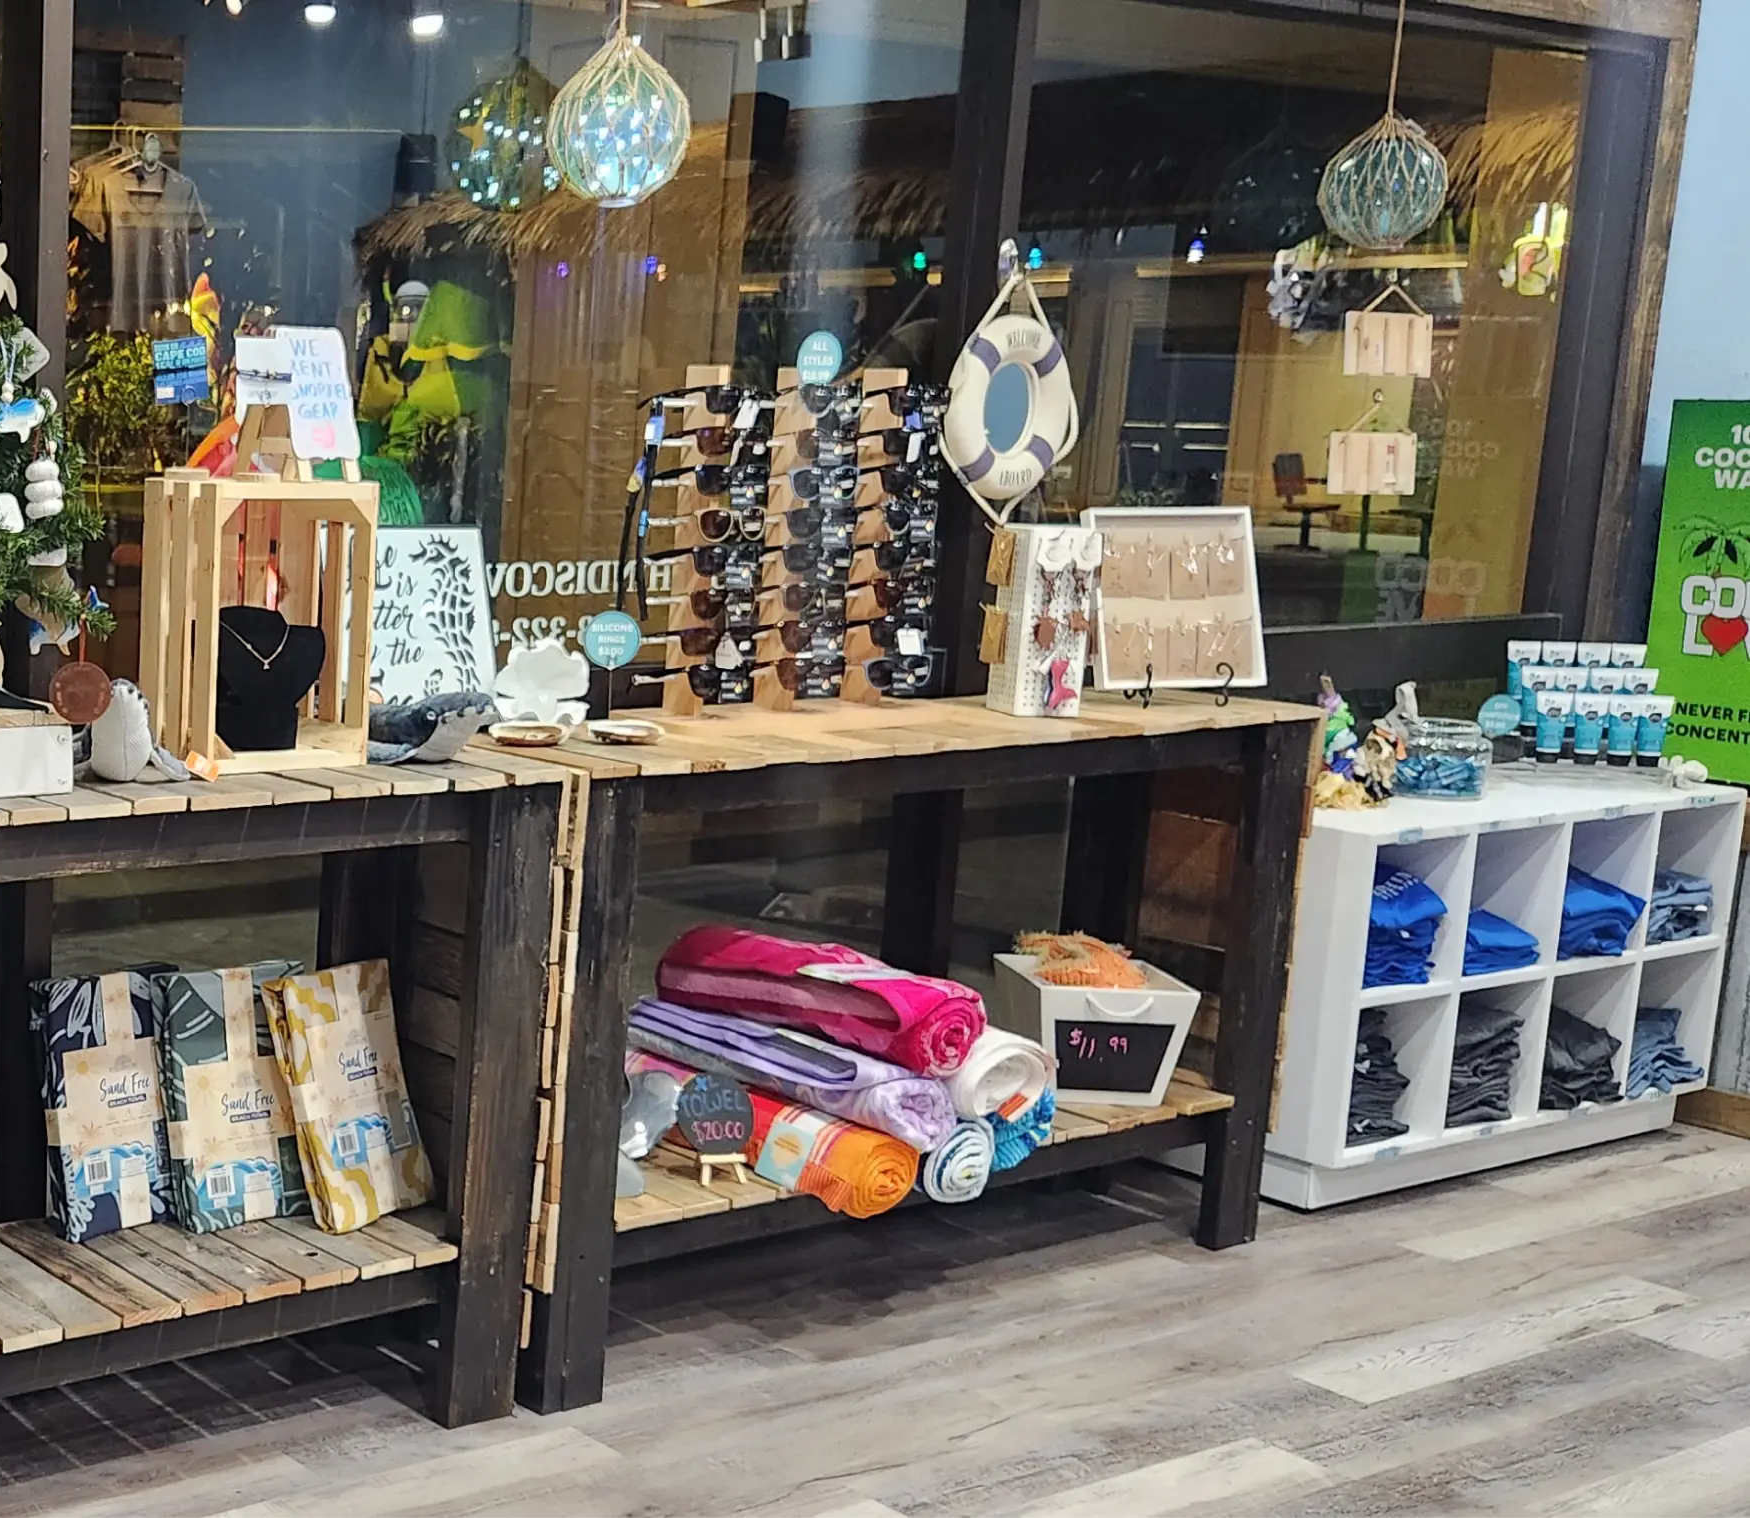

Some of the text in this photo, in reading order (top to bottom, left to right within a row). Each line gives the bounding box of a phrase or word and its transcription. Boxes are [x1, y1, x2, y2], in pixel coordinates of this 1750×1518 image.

[290, 338, 320, 357] WE
[812, 340, 829, 352] ALL
[1005, 328, 1043, 350] WELCOME
[154, 349, 185, 362] CAPE
[186, 346, 206, 358] COD
[802, 355, 834, 366] STYLES
[999, 467, 1033, 487] ABOARD
[395, 571, 419, 598] is
[591, 622, 635, 633] SILICONE
[386, 636, 426, 666] the
[597, 635, 627, 645] RINGS
[1675, 701, 1750, 723] NEVER F
[338, 1045, 378, 1075] Sand Free
[99, 1071, 151, 1102] Sand Free
[220, 1089, 275, 1116] Sand Free
[680, 1089, 747, 1118] TOWEL
[690, 1120, 745, 1146] $20.00
